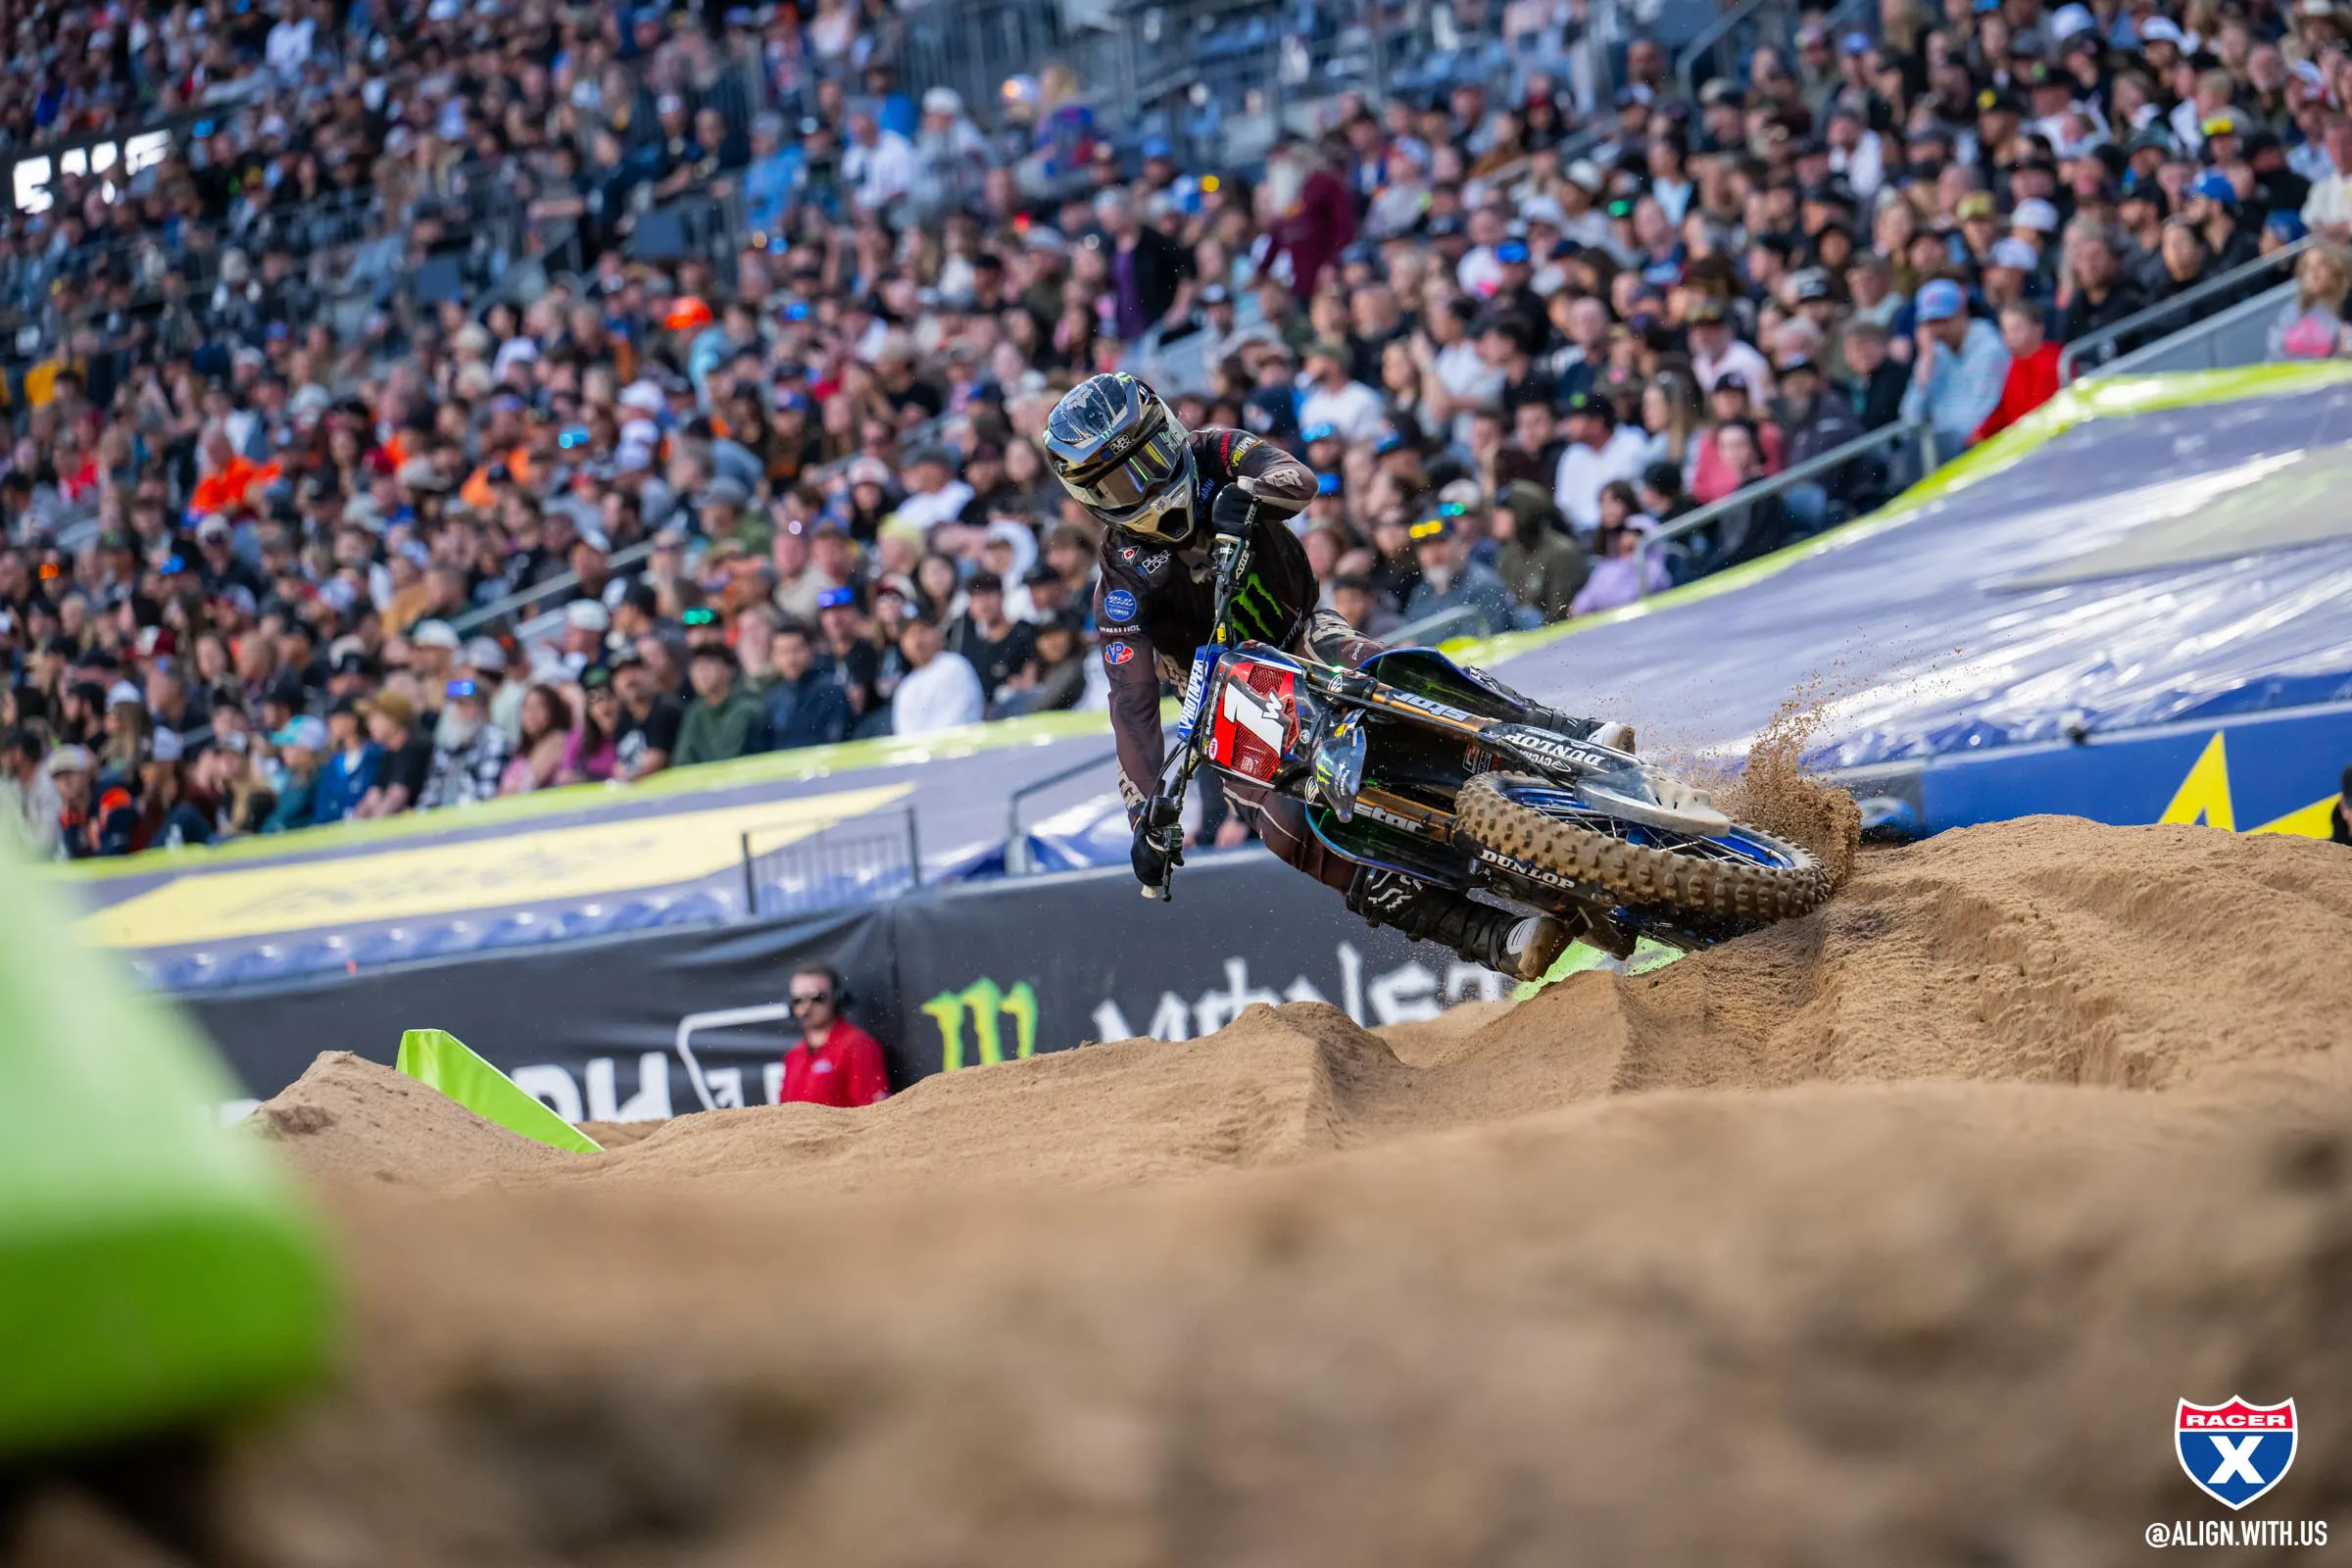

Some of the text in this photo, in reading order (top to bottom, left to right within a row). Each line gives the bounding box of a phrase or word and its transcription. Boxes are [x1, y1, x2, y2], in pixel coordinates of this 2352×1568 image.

[1109, 434, 1129, 450] QUAD
[1113, 439, 1133, 455] LOCK
[1236, 549, 1250, 580] ARC
[1105, 642, 1125, 664] VP
[1505, 732, 1605, 766] DUNLOP
[1479, 850, 1575, 889] DUNLOP
